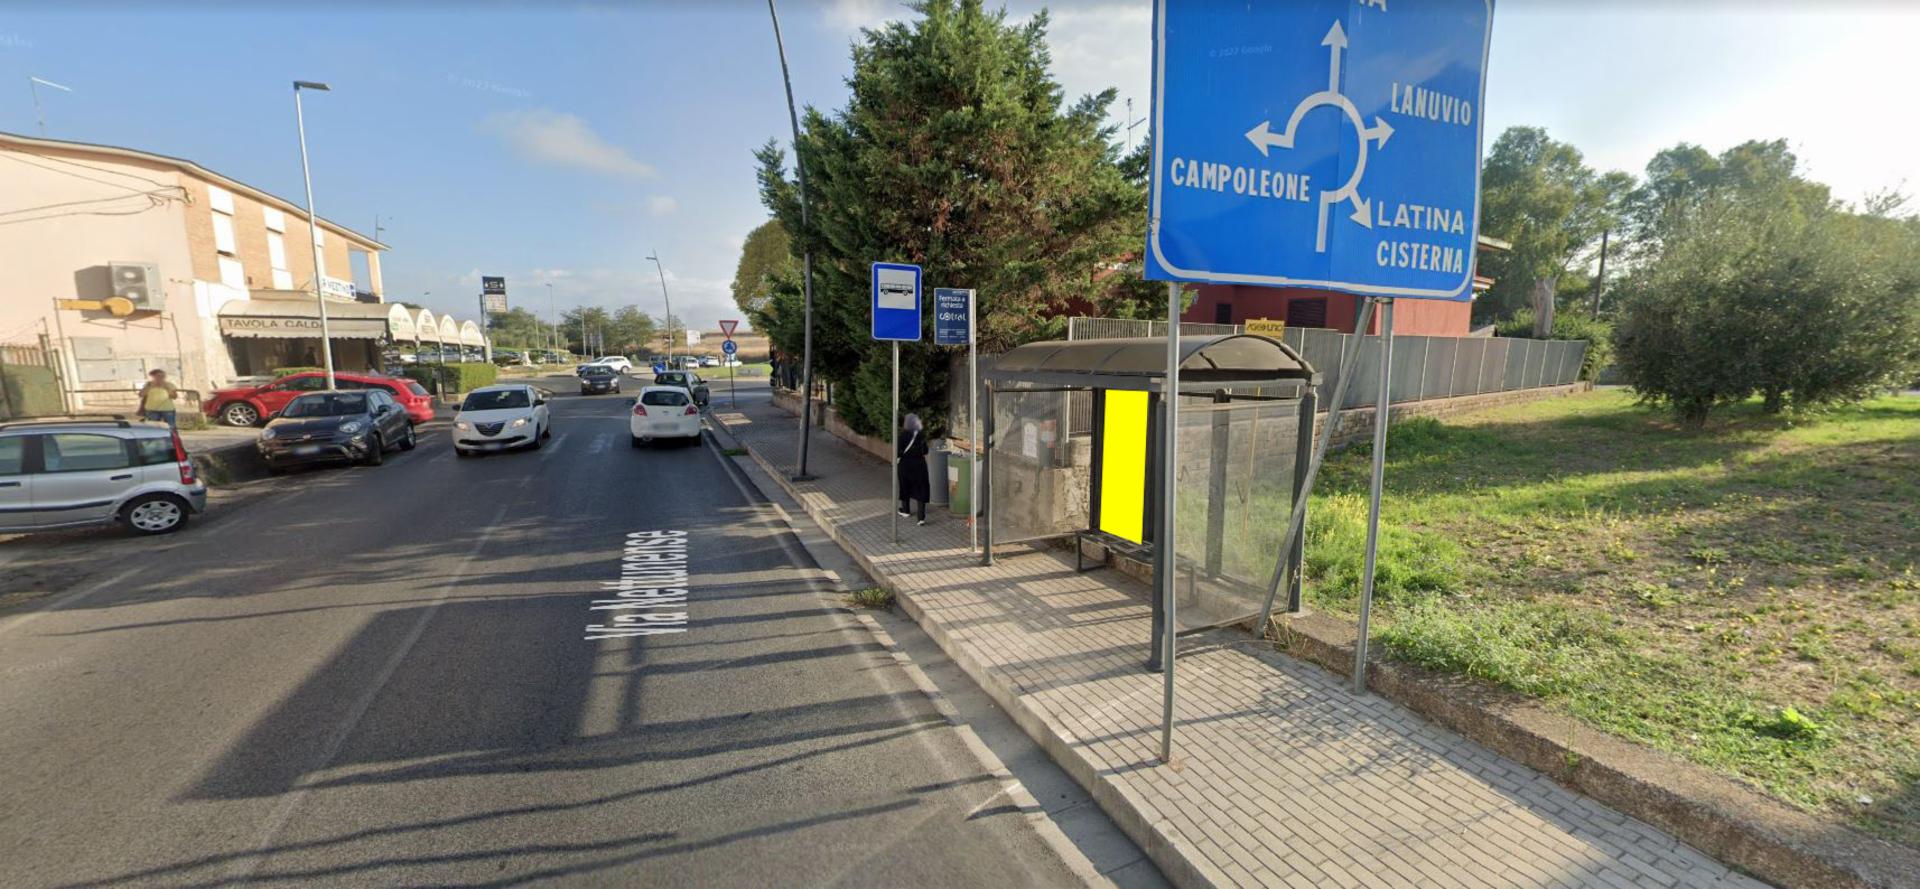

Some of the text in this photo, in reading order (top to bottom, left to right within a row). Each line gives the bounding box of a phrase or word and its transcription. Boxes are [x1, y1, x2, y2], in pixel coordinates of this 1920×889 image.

[1391, 83, 1471, 126] LANUVIO
[1170, 157, 1311, 202] CAMPOLEONE
[1377, 201, 1465, 235] LATINA
[1376, 240, 1463, 274] CISTERNA
[227, 319, 278, 329] TAVOLA
